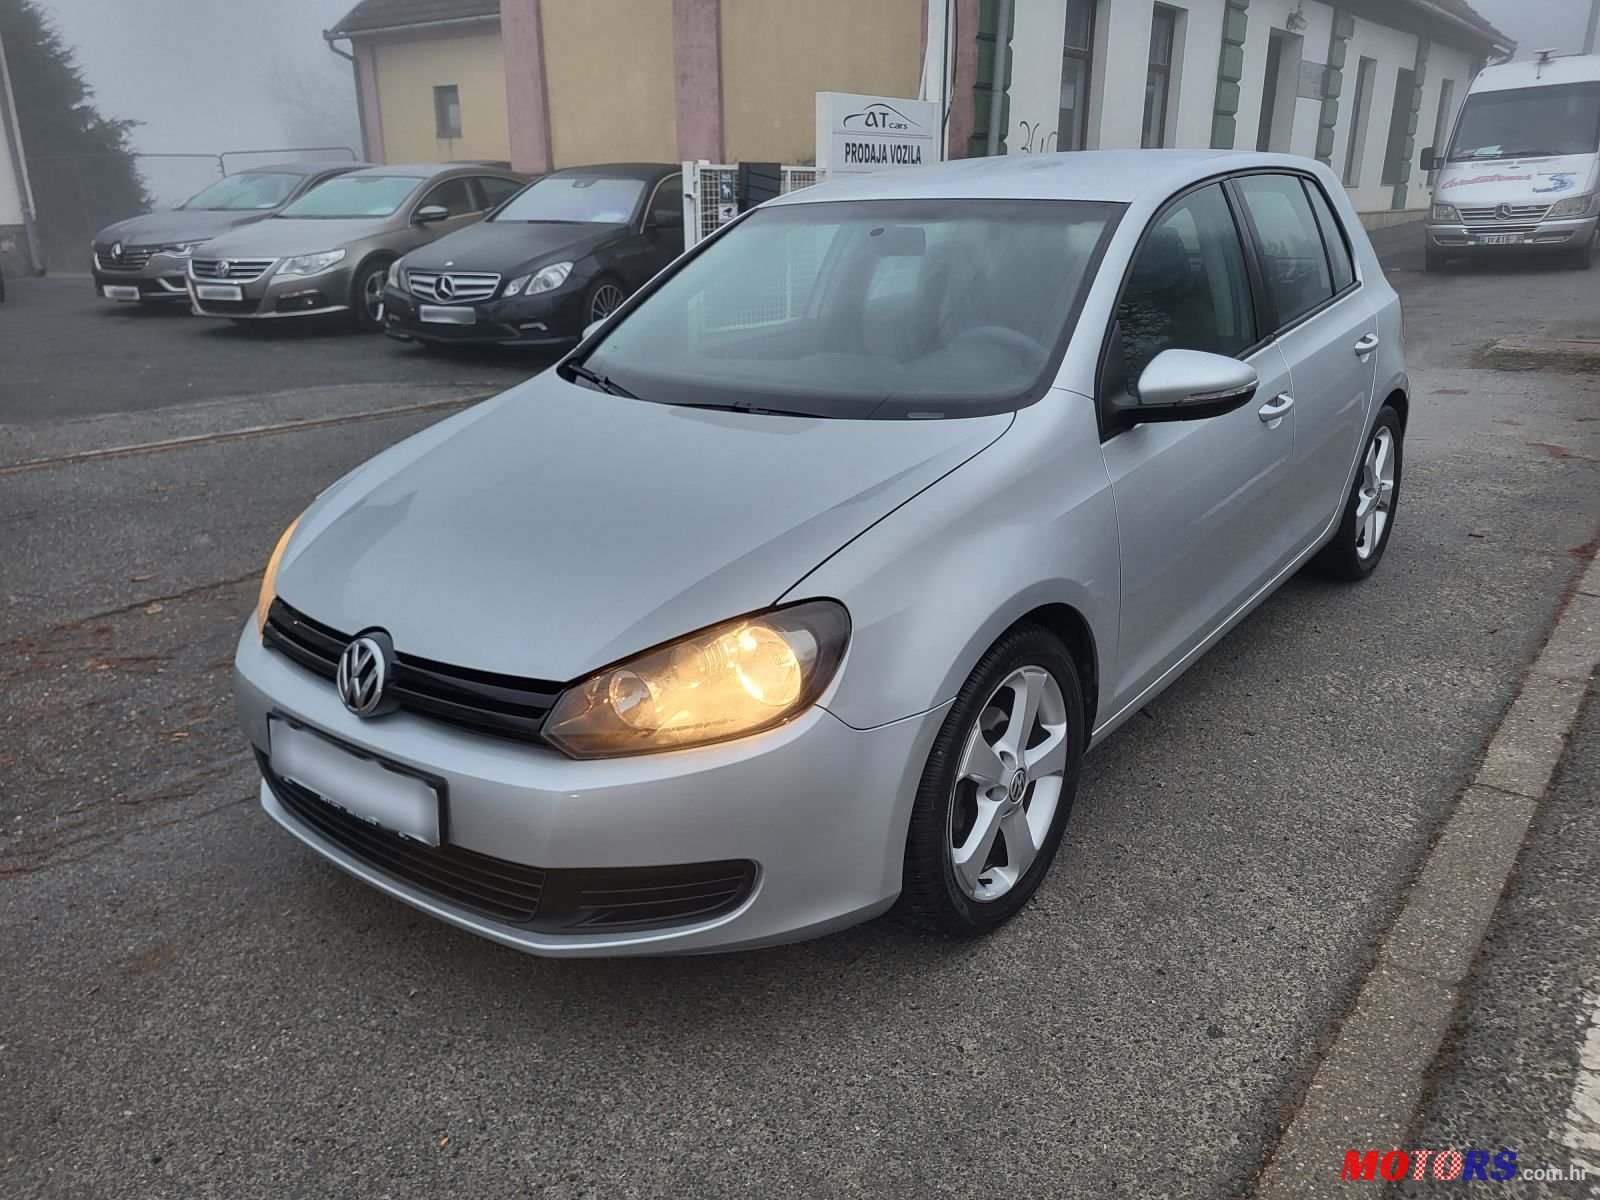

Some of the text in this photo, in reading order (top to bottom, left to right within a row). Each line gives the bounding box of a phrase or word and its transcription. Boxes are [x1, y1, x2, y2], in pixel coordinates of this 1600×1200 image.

[865, 111, 908, 130] AT cars
[845, 142, 922, 165] PRODAJA VOZILA
